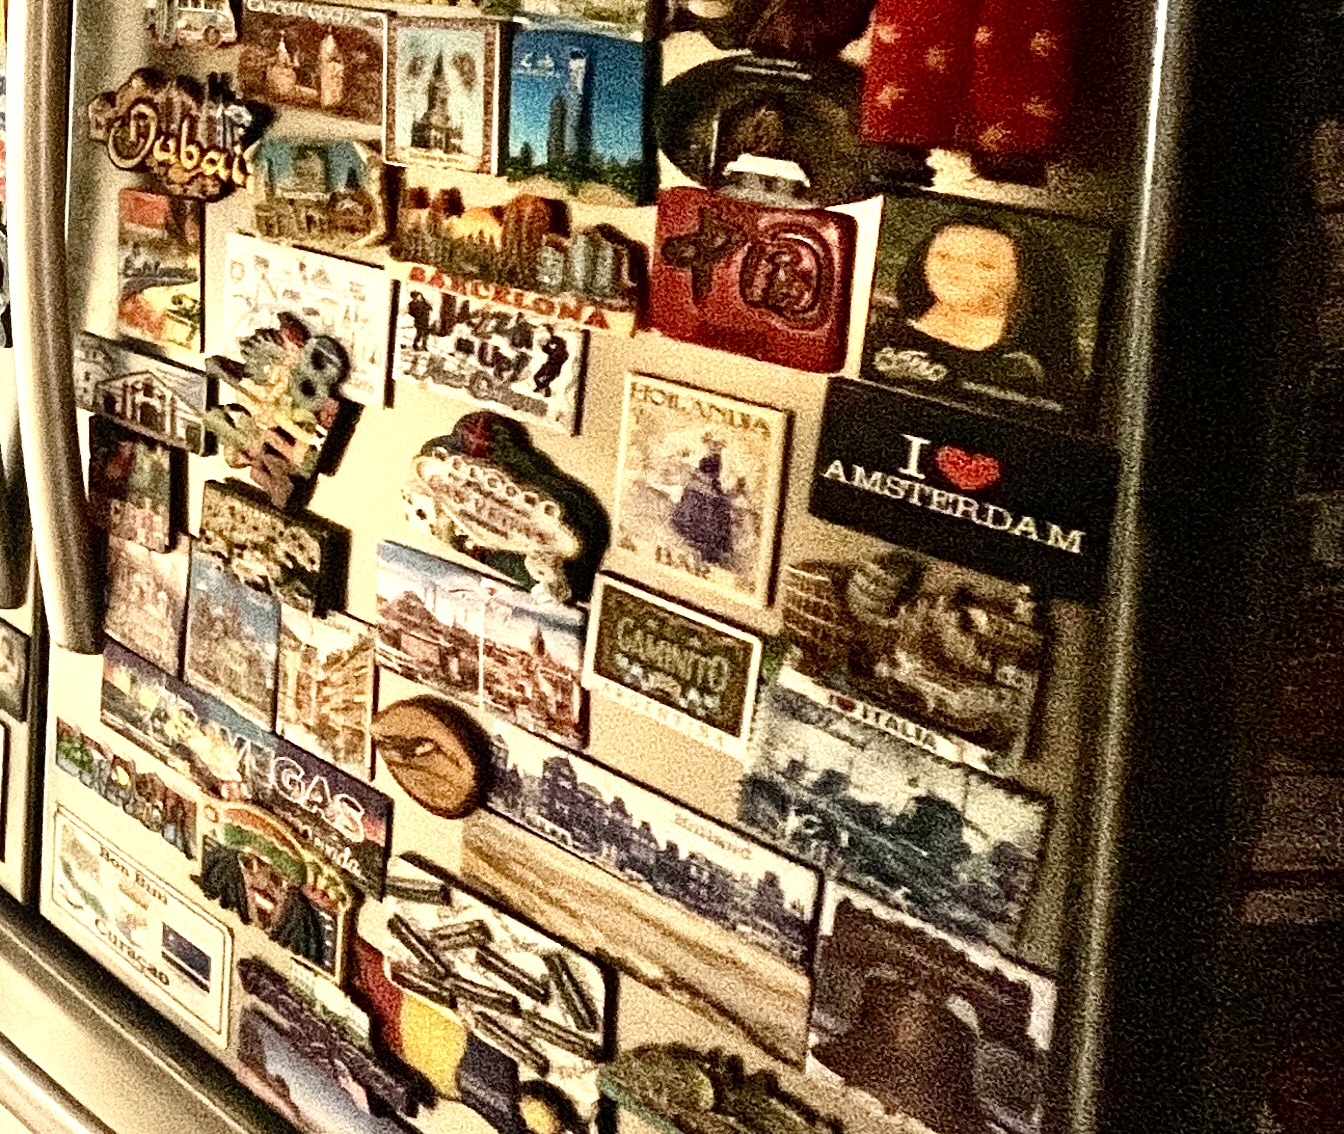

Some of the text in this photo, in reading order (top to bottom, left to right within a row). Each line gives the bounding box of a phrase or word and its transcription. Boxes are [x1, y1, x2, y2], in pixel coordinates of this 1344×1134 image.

[108, 104, 250, 187] Dubai
[408, 267, 610, 331] BARCELONA
[899, 433, 932, 479] I
[823, 459, 1087, 554] AMSTERDAM
[861, 705, 937, 751] ITALIA
[94, 919, 171, 986] Curaçao
